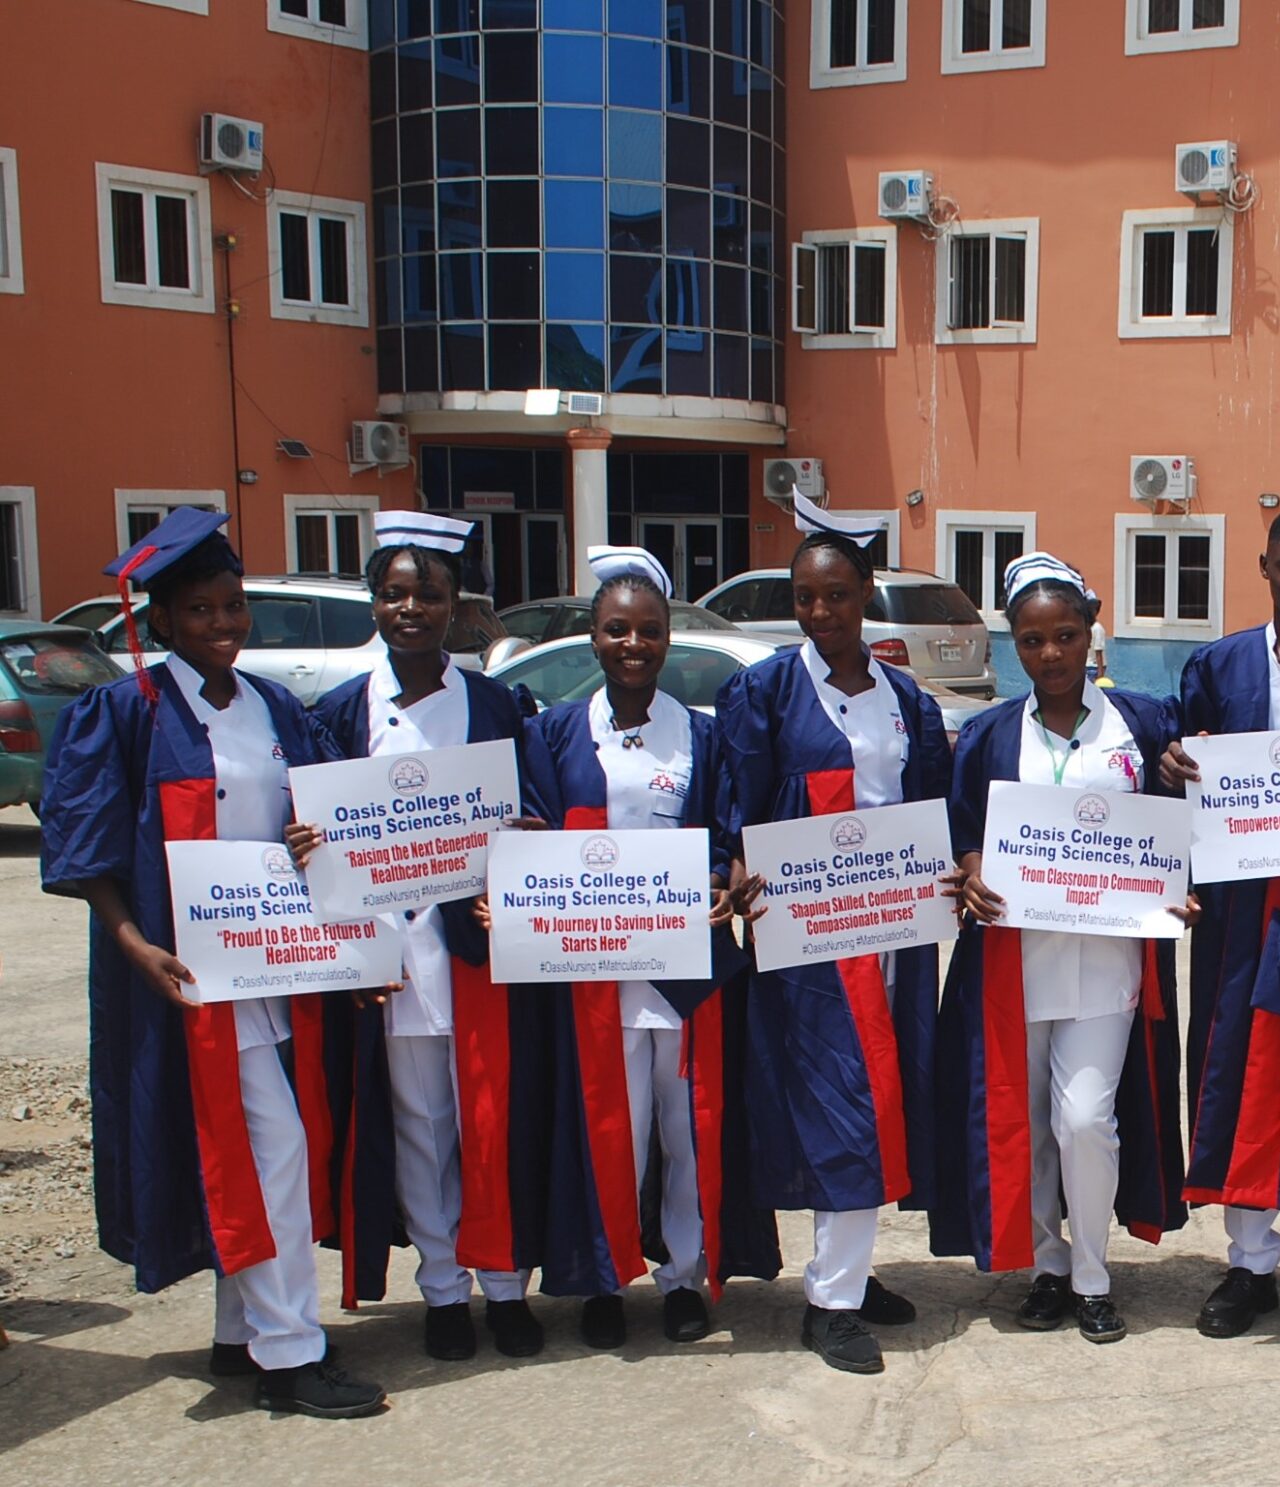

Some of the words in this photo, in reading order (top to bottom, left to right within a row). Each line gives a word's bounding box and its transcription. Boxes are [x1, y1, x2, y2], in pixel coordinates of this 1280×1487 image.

[1220, 774, 1265, 790] Oasis
[335, 803, 386, 822] Oasis
[392, 795, 460, 814] College
[465, 787, 481, 803] of
[1201, 793, 1259, 809] Nursing
[386, 812, 466, 833] Sciences,
[472, 801, 513, 821] Abuja
[1020, 825, 1065, 841] Oasis
[1071, 829, 1133, 850] College
[1139, 836, 1154, 850] of
[391, 844, 409, 861] the
[410, 840, 434, 858] Next
[781, 859, 827, 877] Oasis
[833, 851, 894, 869] College
[900, 844, 914, 859] of
[998, 839, 1056, 861] Nursing
[1062, 845, 1134, 868] Sciences,
[1140, 852, 1181, 872] Abuja
[371, 863, 429, 884] Healthcare
[525, 874, 573, 889] Oasis
[580, 873, 646, 890] College
[653, 871, 669, 886] of
[763, 878, 822, 897] Nursing
[827, 868, 899, 887] Sciences,
[905, 858, 945, 876] Abuja
[1047, 868, 1098, 888] Classroom
[1100, 874, 1109, 889] to
[1111, 874, 1165, 895] Community
[210, 884, 261, 900] Oasis
[267, 882, 308, 897] Colle
[363, 889, 420, 906] #OasisNursing
[504, 892, 566, 910] Nursing
[572, 891, 650, 907] Sciences,
[656, 889, 701, 907] Abuja
[917, 883, 934, 899] and
[189, 903, 256, 921] Nursing
[261, 900, 312, 916] Scienc
[1024, 908, 1076, 925] #OasisNursing
[1078, 912, 1140, 928] #MatriculationDay
[265, 929, 278, 945] to
[281, 926, 298, 943] Be
[300, 925, 320, 942] the
[322, 923, 361, 940] Future
[363, 921, 375, 938] of
[553, 917, 598, 933] Journey
[601, 917, 612, 931] to
[615, 915, 654, 932] Saving
[657, 914, 685, 929] Lives
[806, 912, 879, 935] Compassionate
[562, 937, 597, 952] Starts
[802, 939, 855, 955] #OasisNursing
[856, 928, 917, 946] #MatriculationDay
[540, 961, 596, 974] #OasisNursing
[598, 958, 665, 972] #MatriculationDay
[232, 974, 292, 988] #OasisNursing
[294, 967, 362, 982] #MatriculationDay
